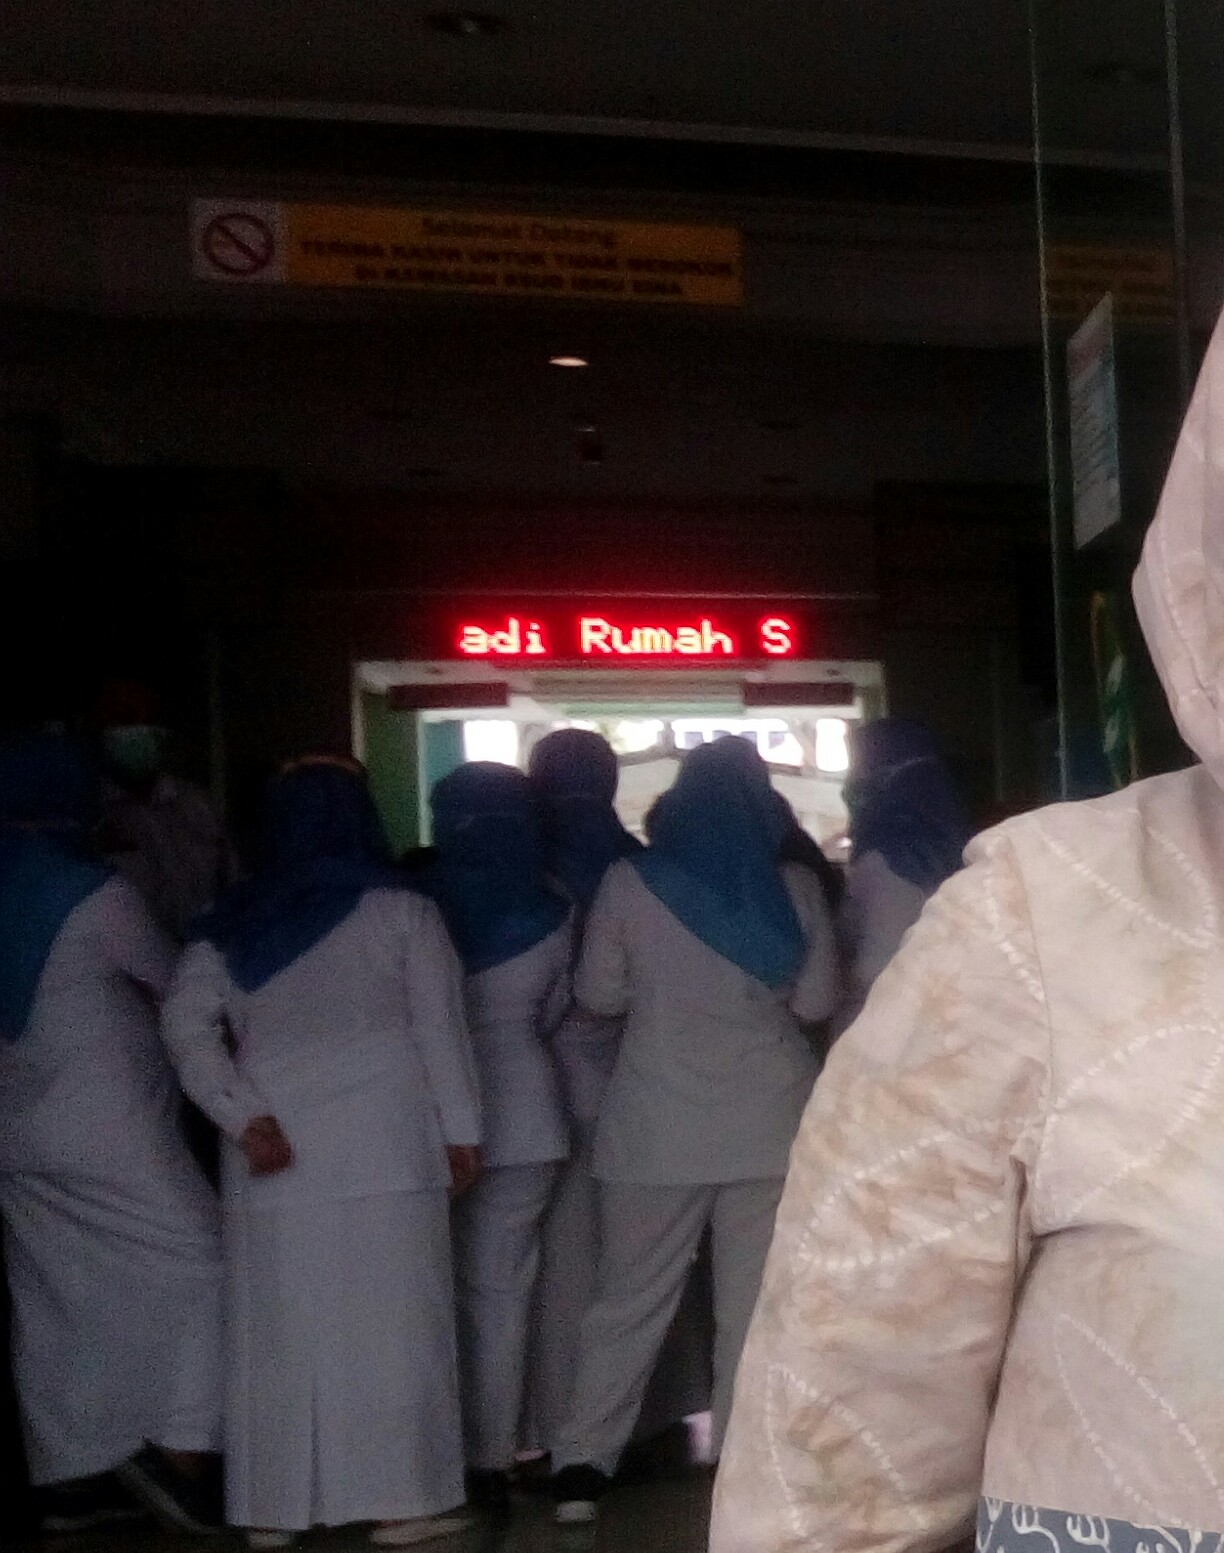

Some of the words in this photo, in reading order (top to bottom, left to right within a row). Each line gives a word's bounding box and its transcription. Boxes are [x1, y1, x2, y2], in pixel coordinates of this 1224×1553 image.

[458, 616, 546, 655] adi
[579, 616, 734, 655] Rumah
[760, 617, 792, 655] S
